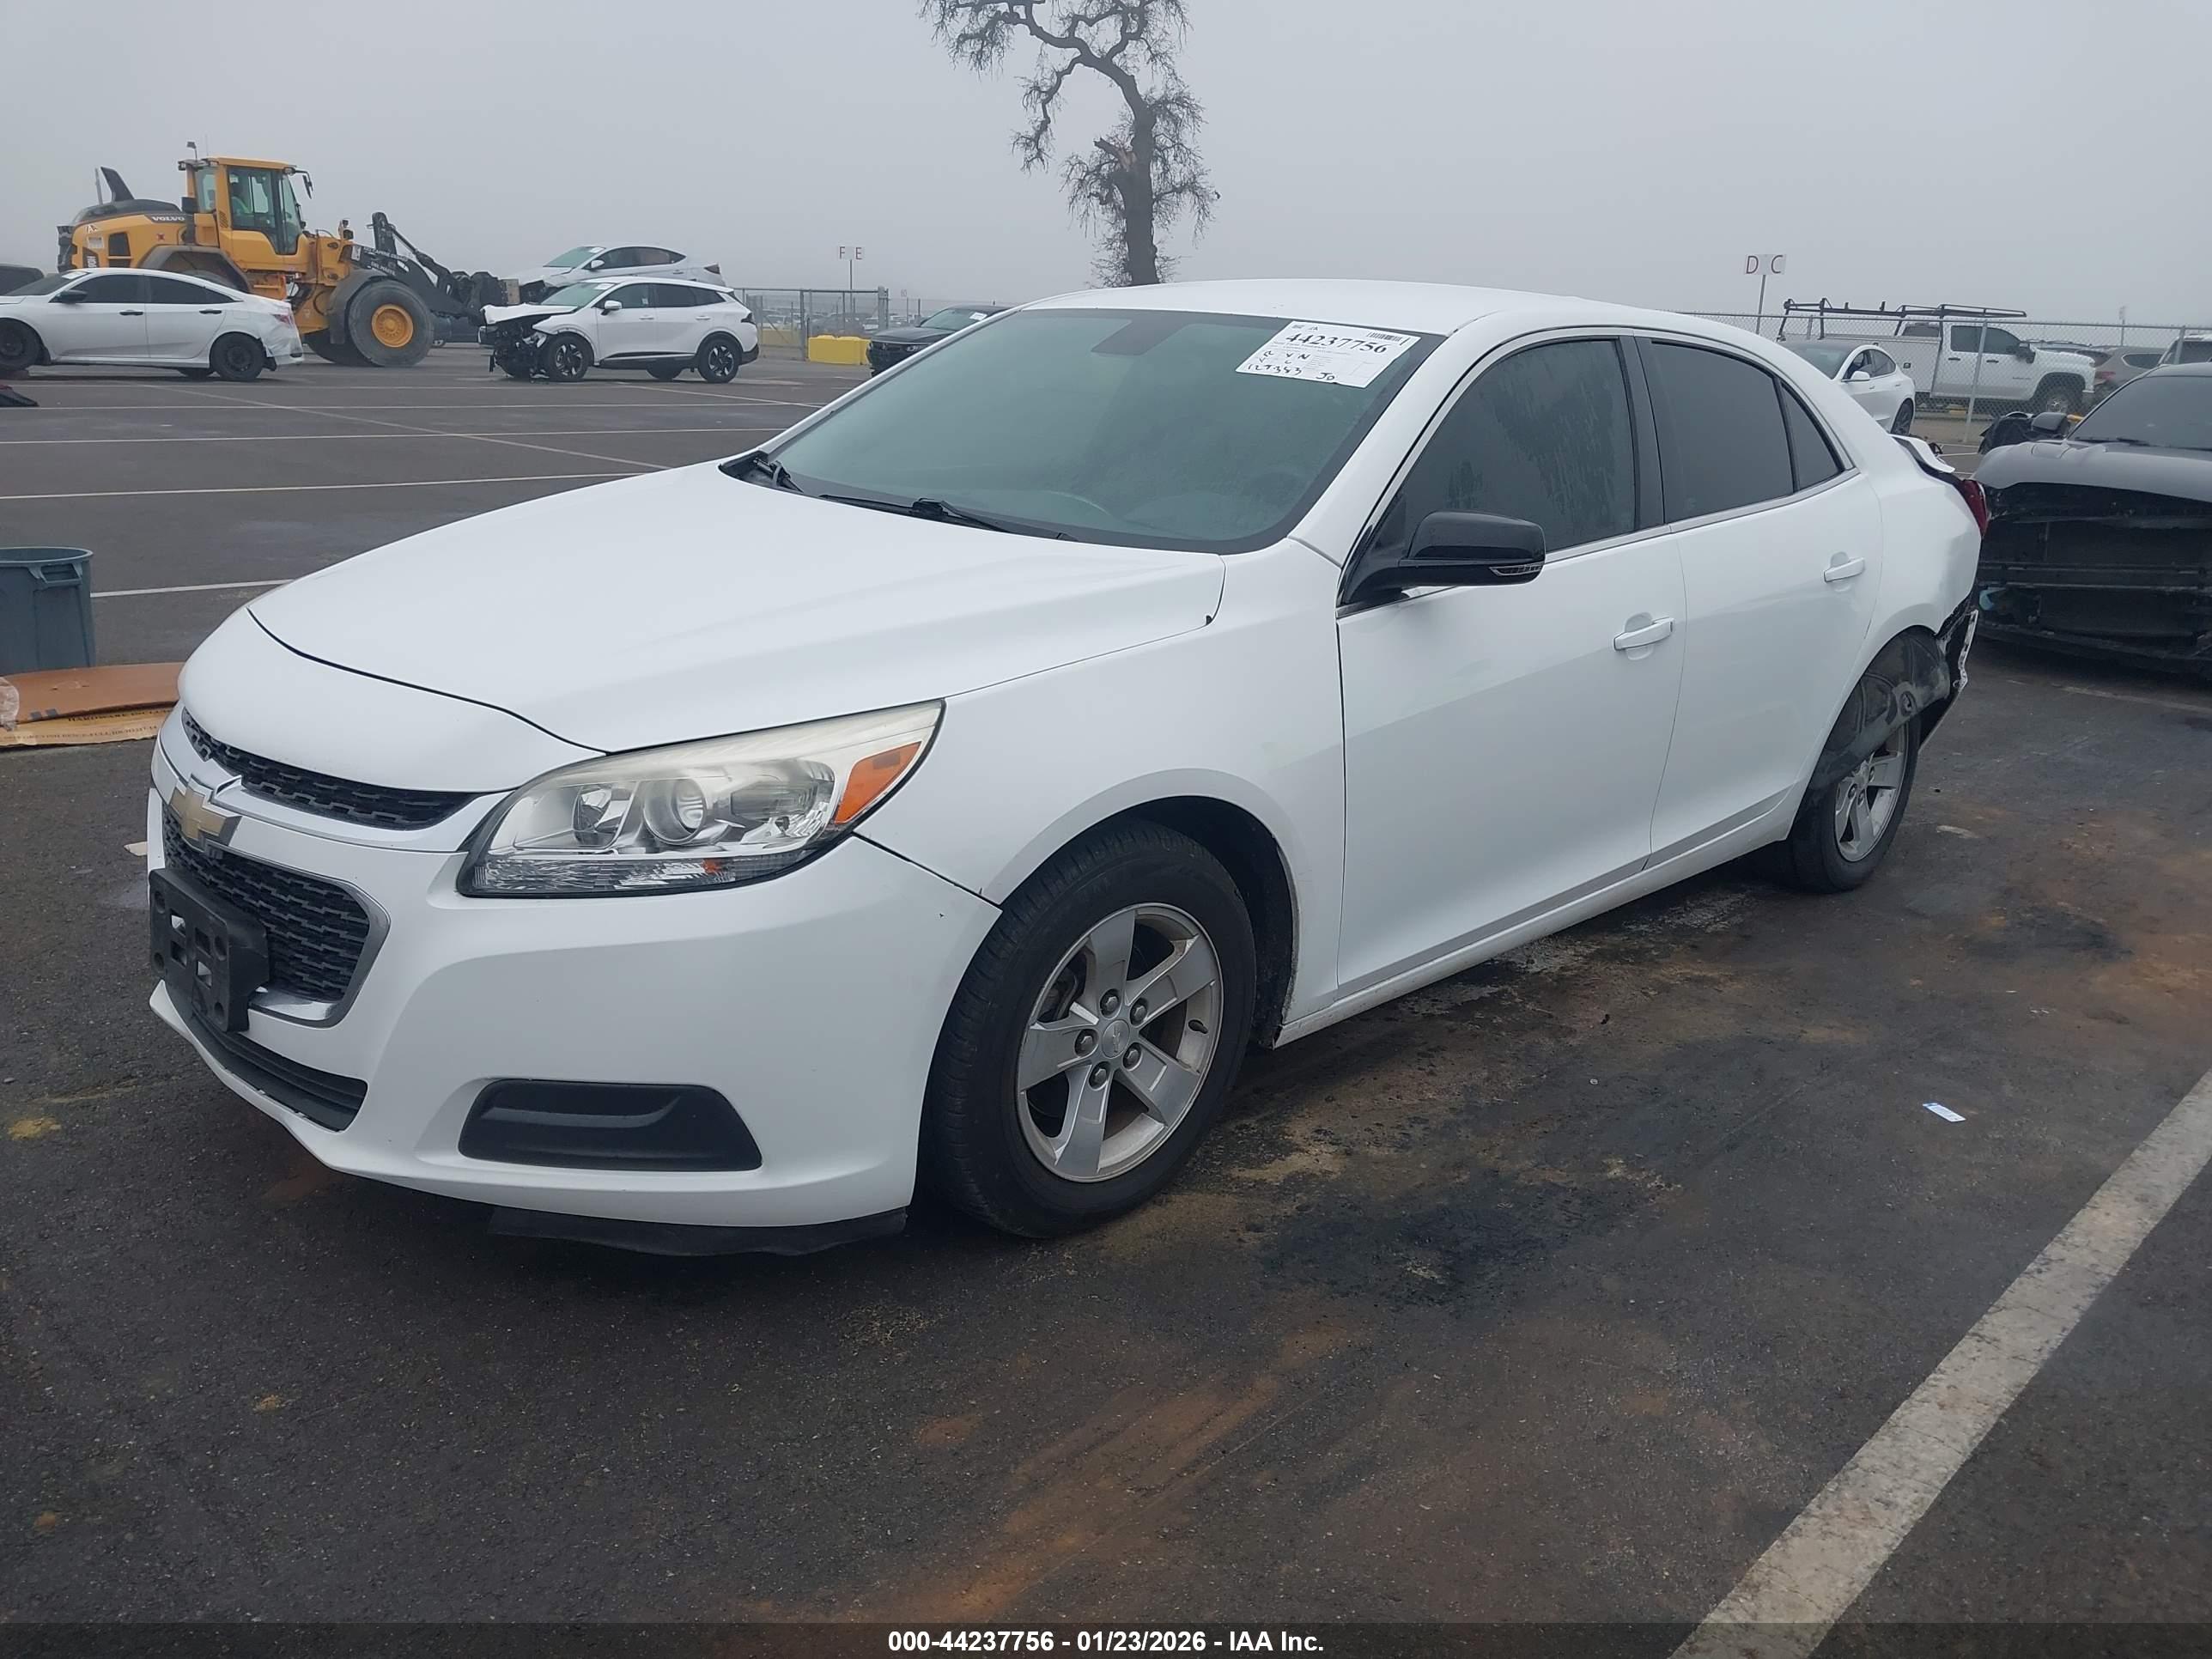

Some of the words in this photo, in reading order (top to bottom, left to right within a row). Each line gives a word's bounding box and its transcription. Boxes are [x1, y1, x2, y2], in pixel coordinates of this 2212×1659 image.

[839, 246, 846, 259] F
[855, 246, 863, 260] E
[1746, 255, 1759, 274] D
[1771, 254, 1784, 274] C
[1286, 332, 1389, 353] 44237756
